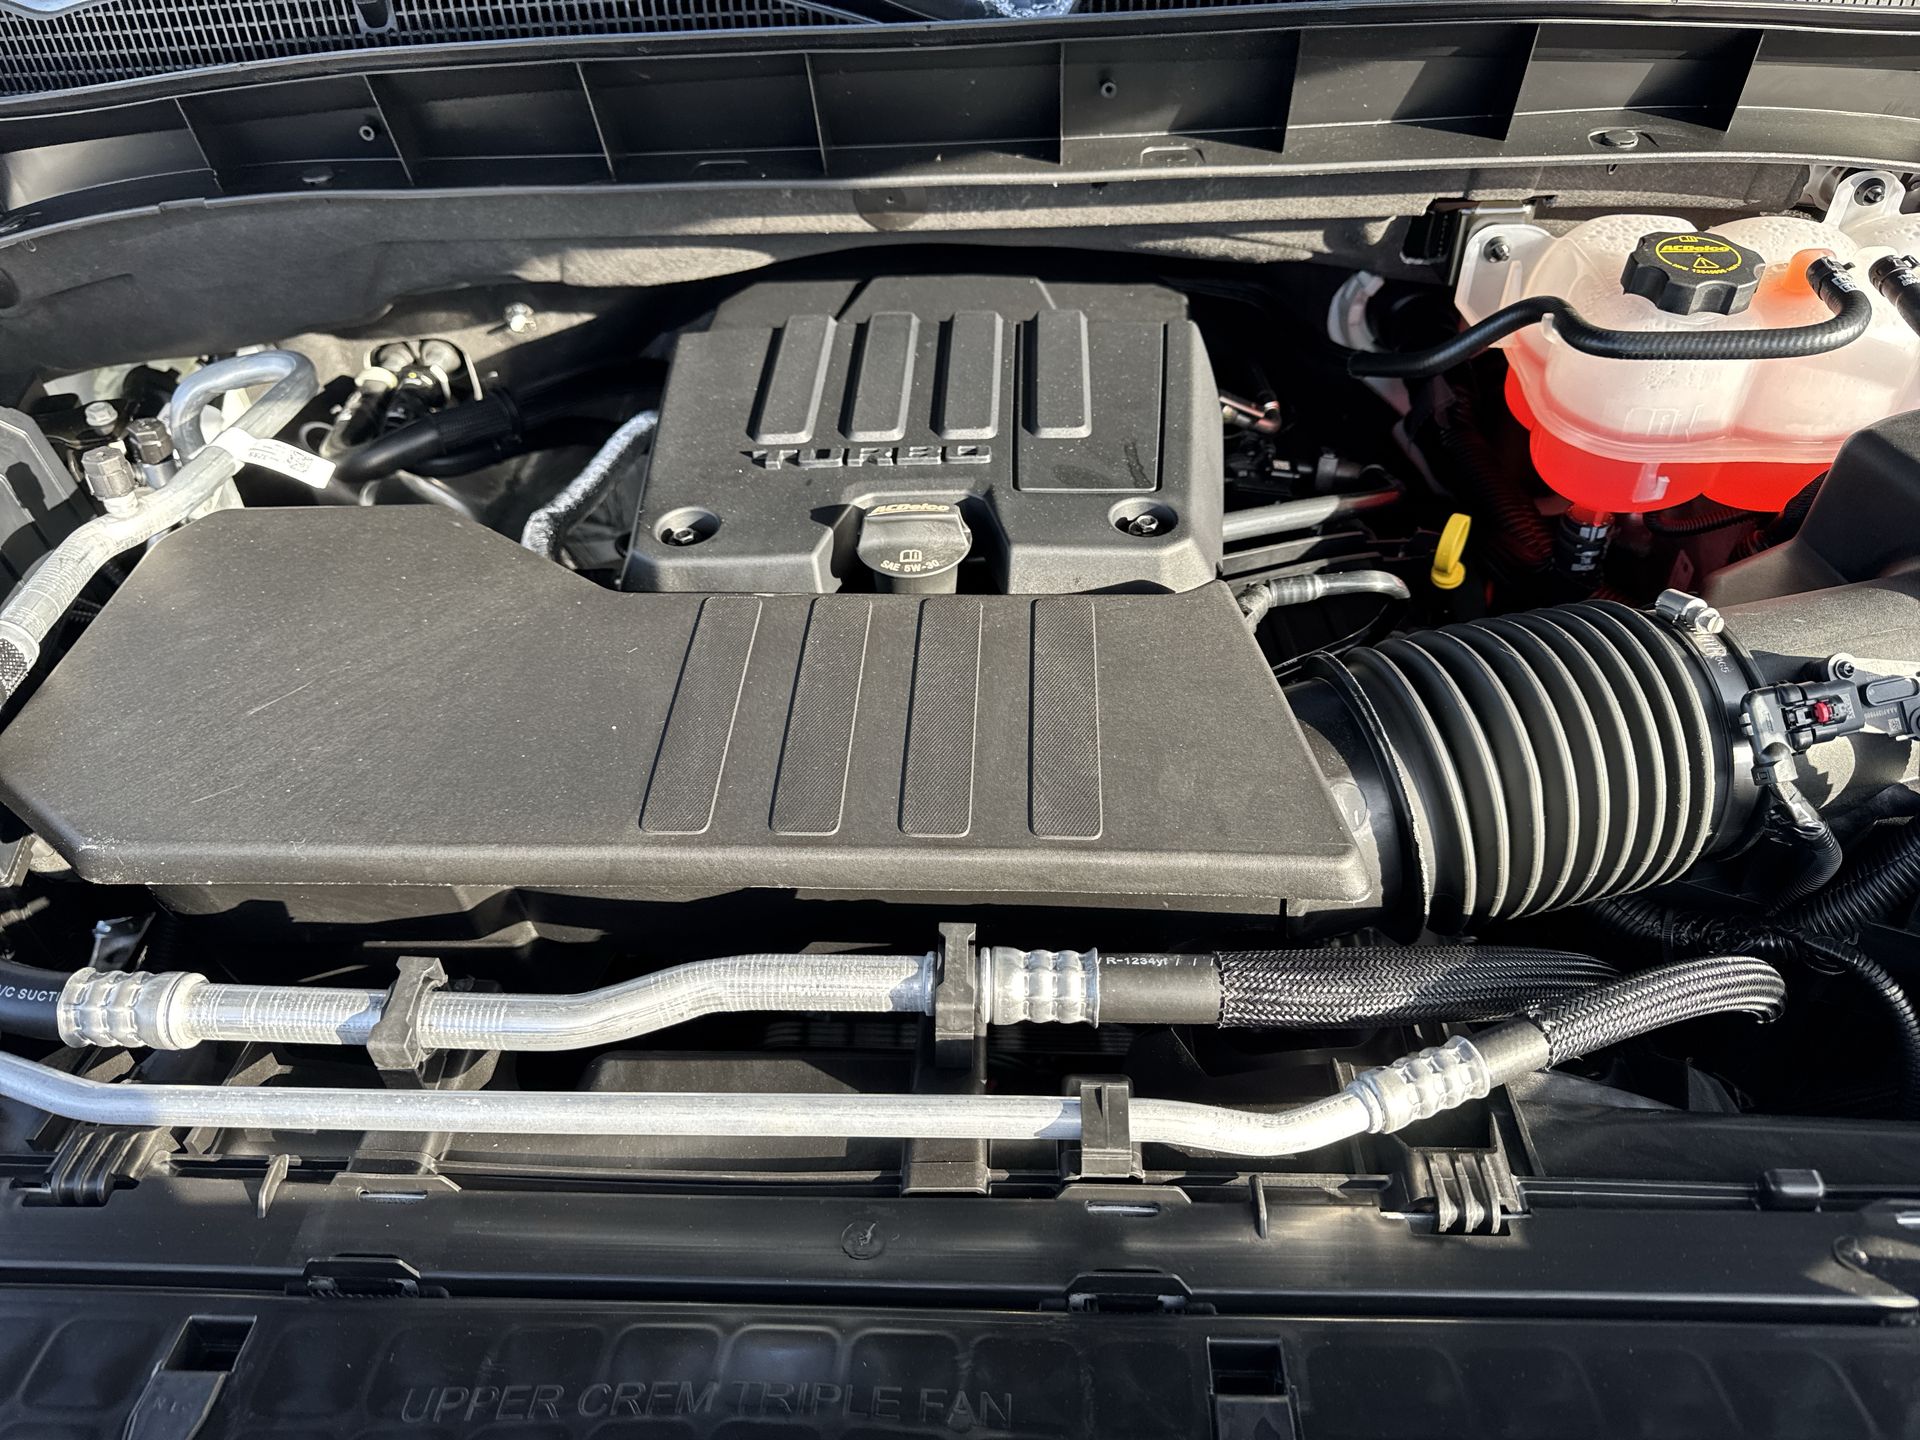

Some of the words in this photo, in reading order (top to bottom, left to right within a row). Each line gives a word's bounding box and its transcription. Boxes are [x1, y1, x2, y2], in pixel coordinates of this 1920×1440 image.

[1660, 244, 1731, 254] ACDelco
[750, 445, 992, 470] TURBO
[868, 503, 950, 516] ACDelco
[880, 559, 901, 573] SAE
[904, 559, 940, 573] 5W-30
[0, 984, 16, 998] /C
[401, 1385, 565, 1423] UPPER
[731, 1380, 902, 1422] TRIPLE
[918, 1387, 1012, 1429] FAN
